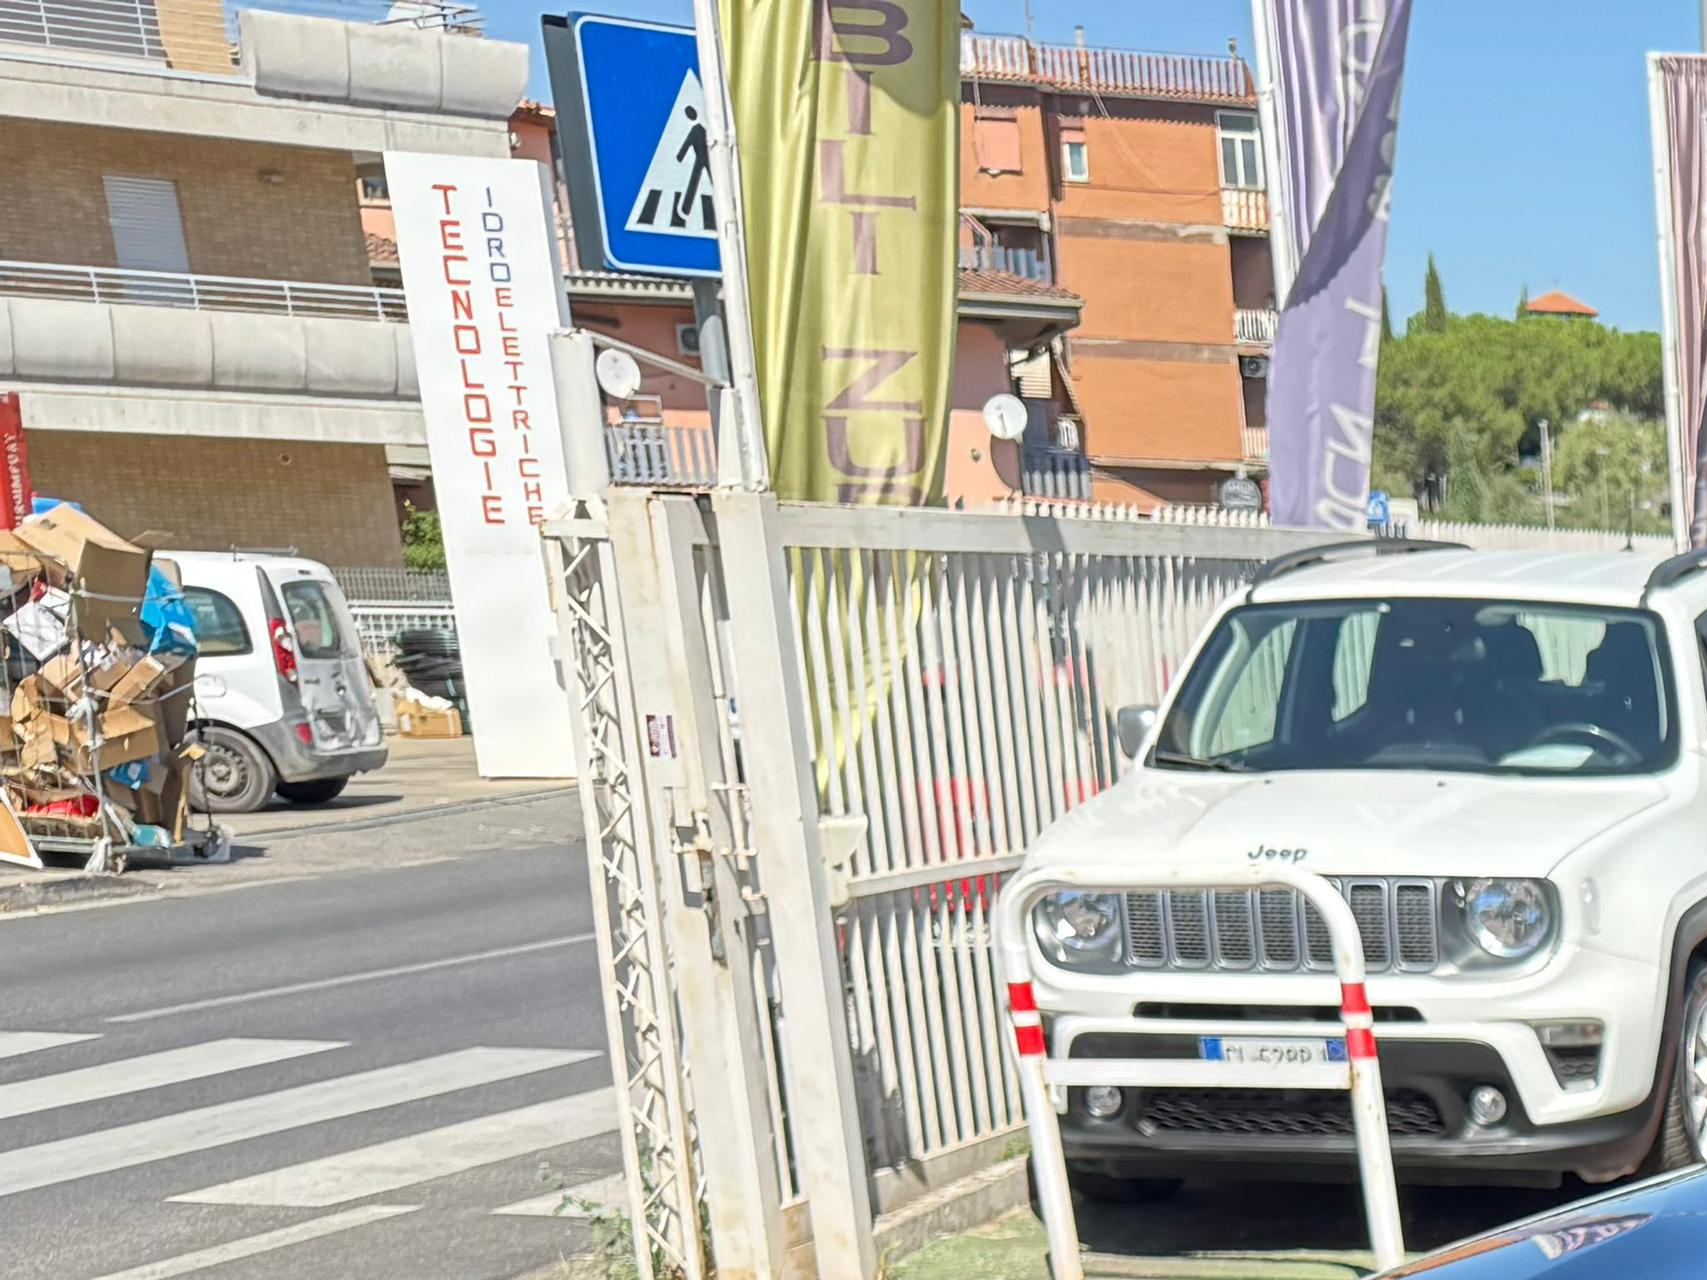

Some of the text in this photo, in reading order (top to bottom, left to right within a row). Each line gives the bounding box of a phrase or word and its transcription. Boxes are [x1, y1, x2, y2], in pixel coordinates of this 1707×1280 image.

[431, 184, 505, 524] TECNOLOGIE
[482, 187, 543, 525] IDROELETTRICHE
[1247, 844, 1308, 865] Jeep
